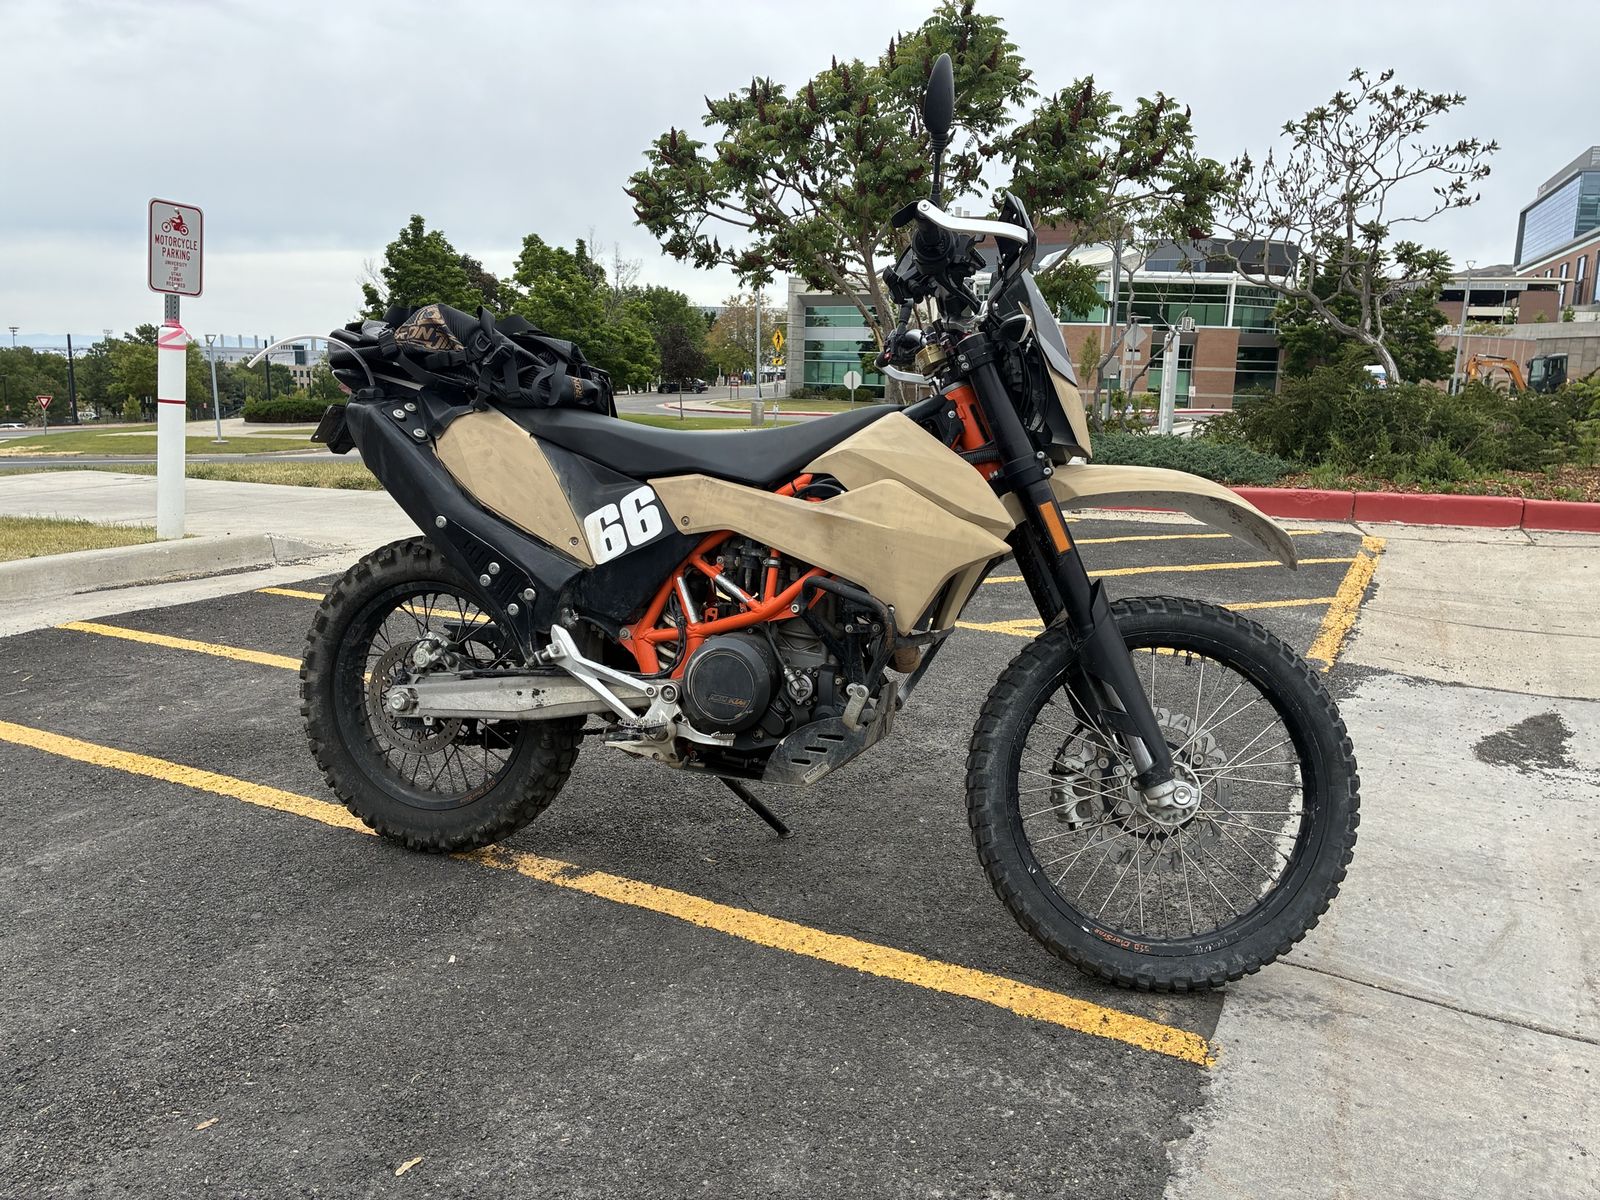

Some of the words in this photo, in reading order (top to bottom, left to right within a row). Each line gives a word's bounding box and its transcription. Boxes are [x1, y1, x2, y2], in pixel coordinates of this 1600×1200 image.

[155, 233, 197, 250] MOTORCYCLE
[162, 247, 190, 261] PARKING
[584, 485, 663, 565] 66
